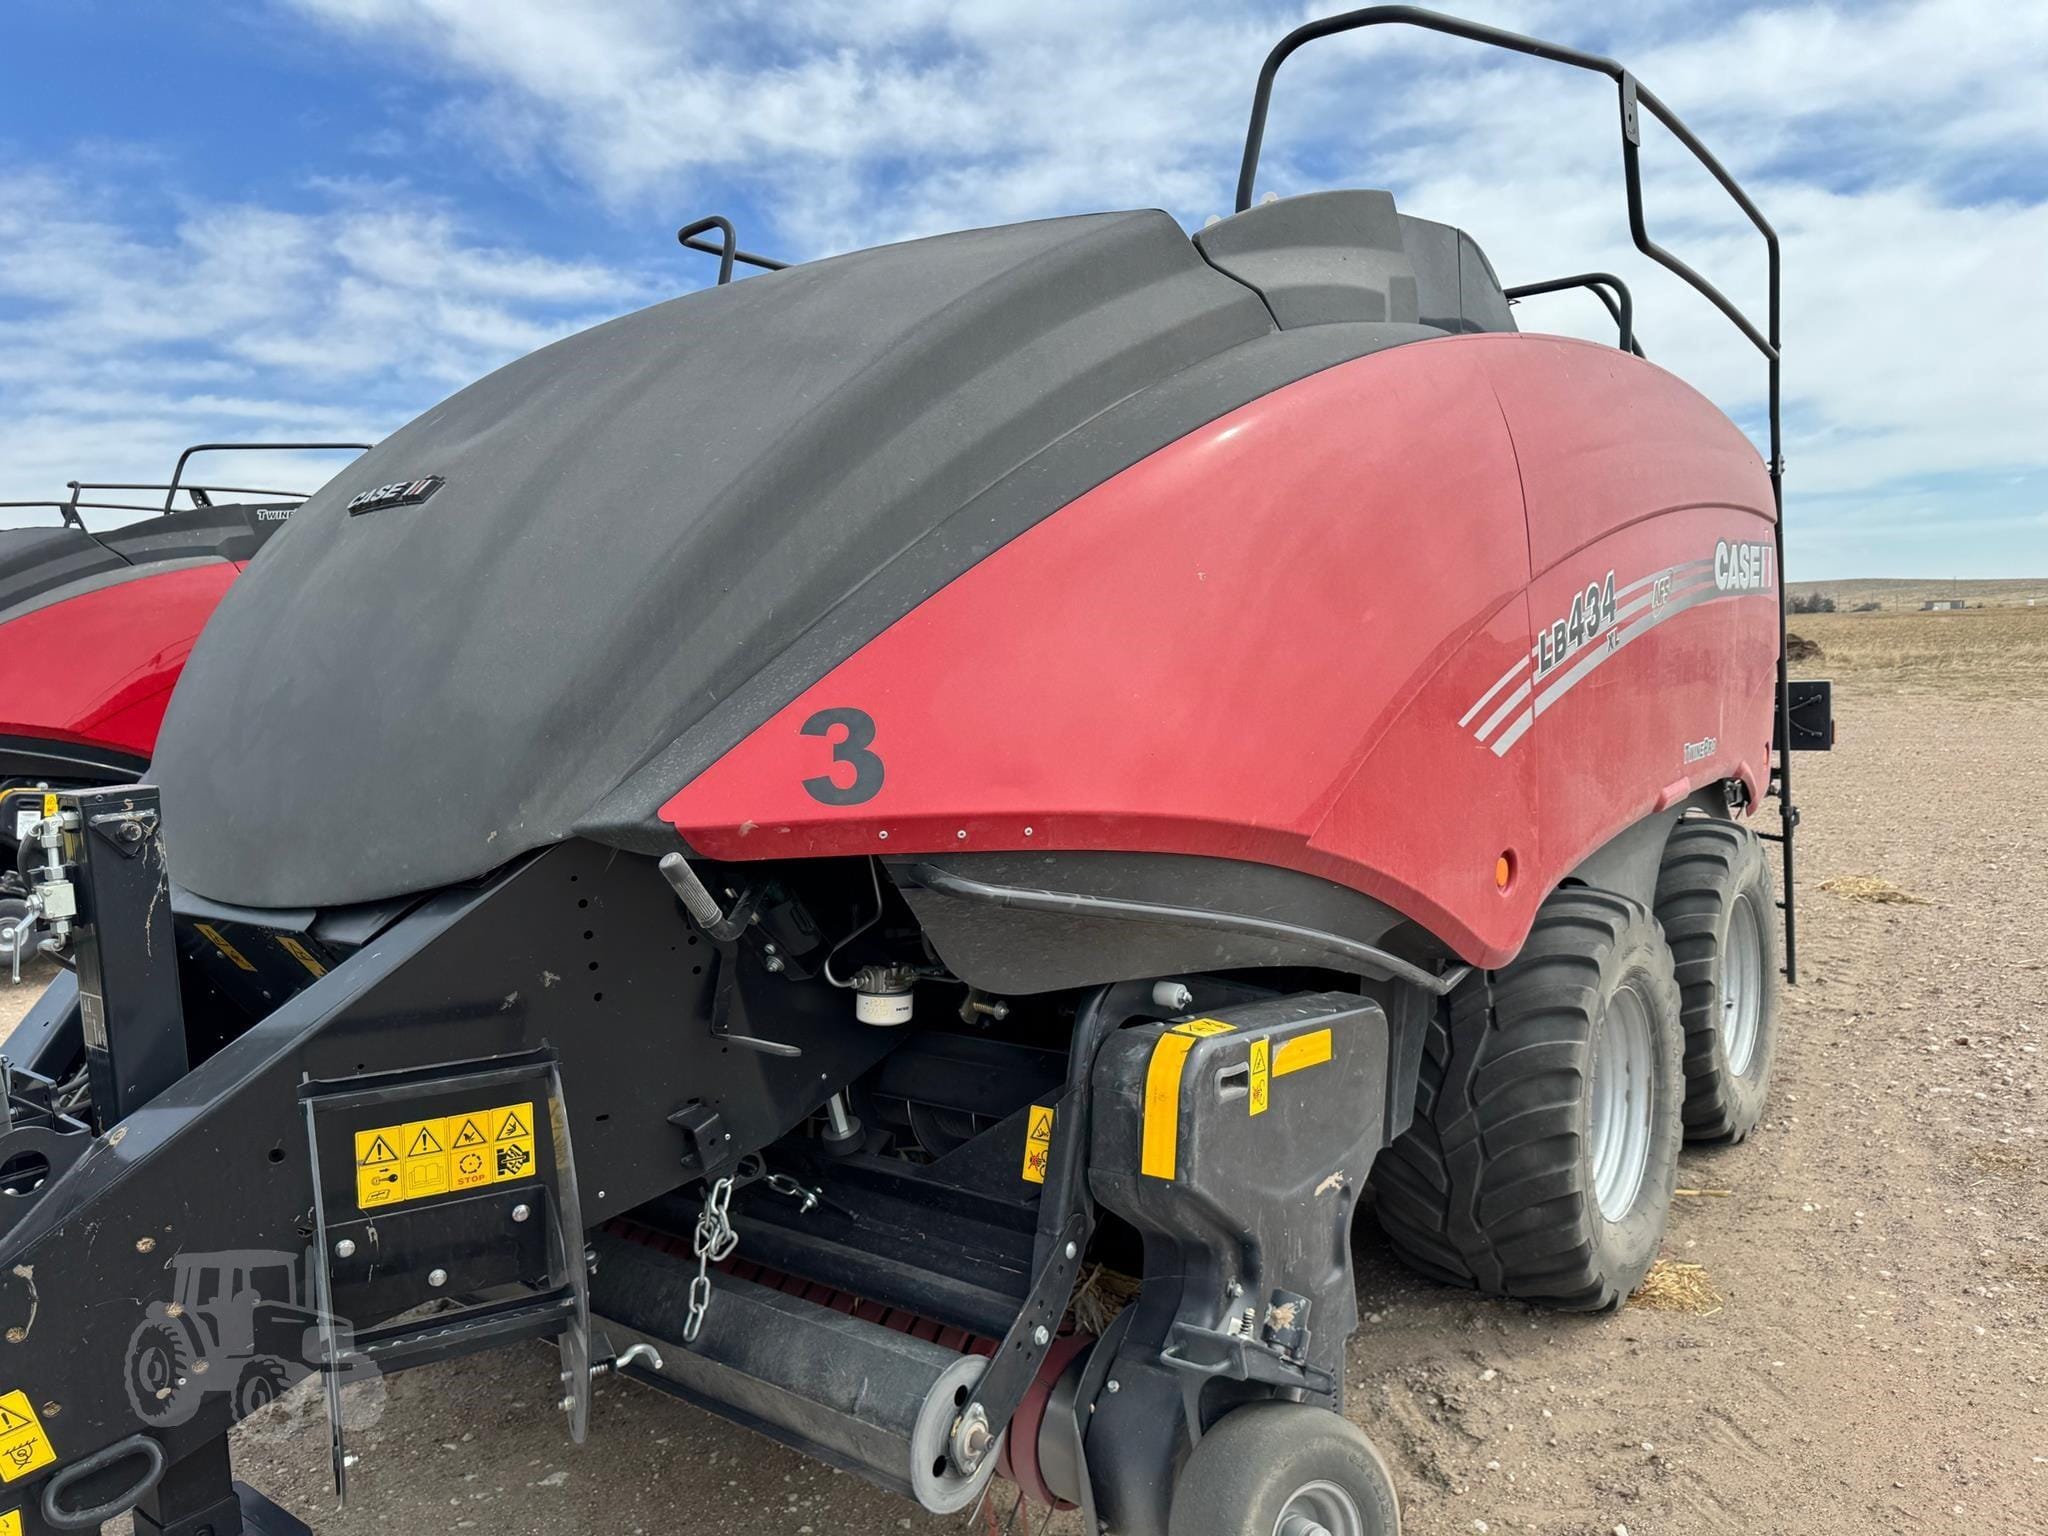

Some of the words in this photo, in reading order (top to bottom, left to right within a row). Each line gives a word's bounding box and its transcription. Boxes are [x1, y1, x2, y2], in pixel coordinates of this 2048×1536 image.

[1538, 569, 1617, 677] LB434
[1606, 627, 1620, 653] XL
[800, 707, 885, 807] 3
[457, 1174, 485, 1185] STOP
